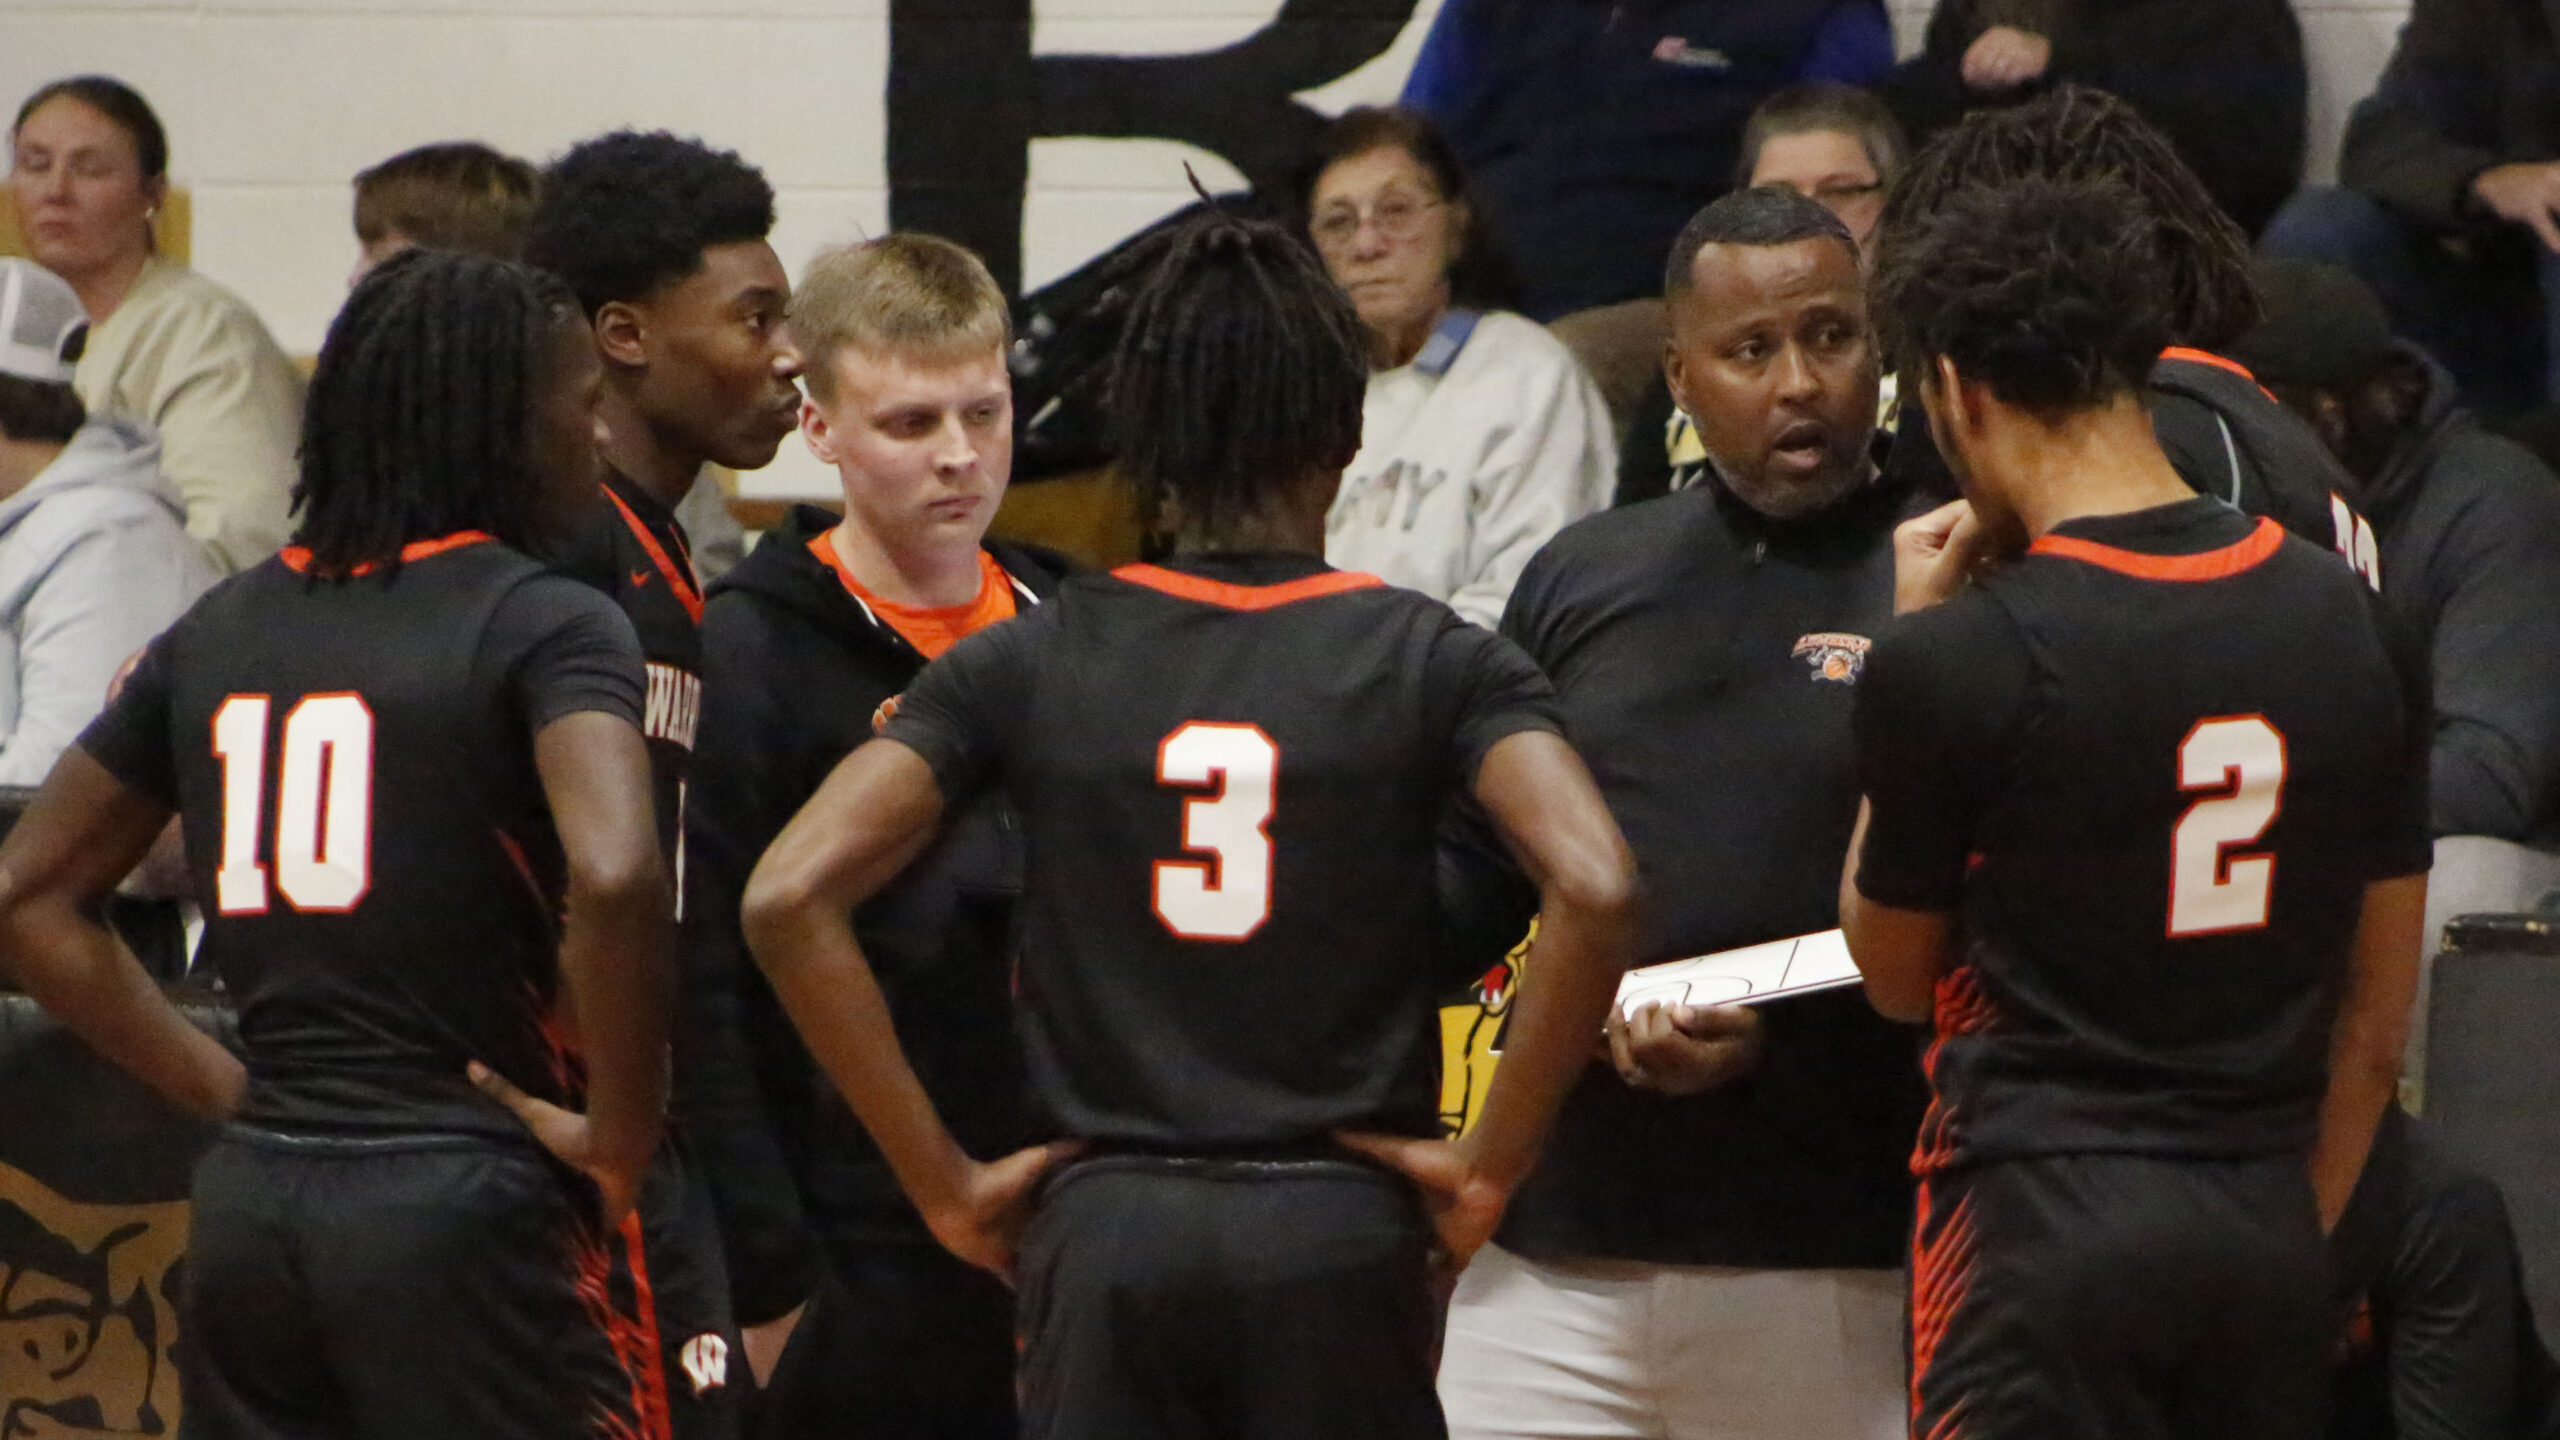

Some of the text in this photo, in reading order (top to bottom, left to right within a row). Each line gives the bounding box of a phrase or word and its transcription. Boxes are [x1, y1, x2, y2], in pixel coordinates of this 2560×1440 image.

[210, 690, 376, 915] 10
[1152, 719, 1281, 943] 3
[2165, 712, 2288, 938] 2
